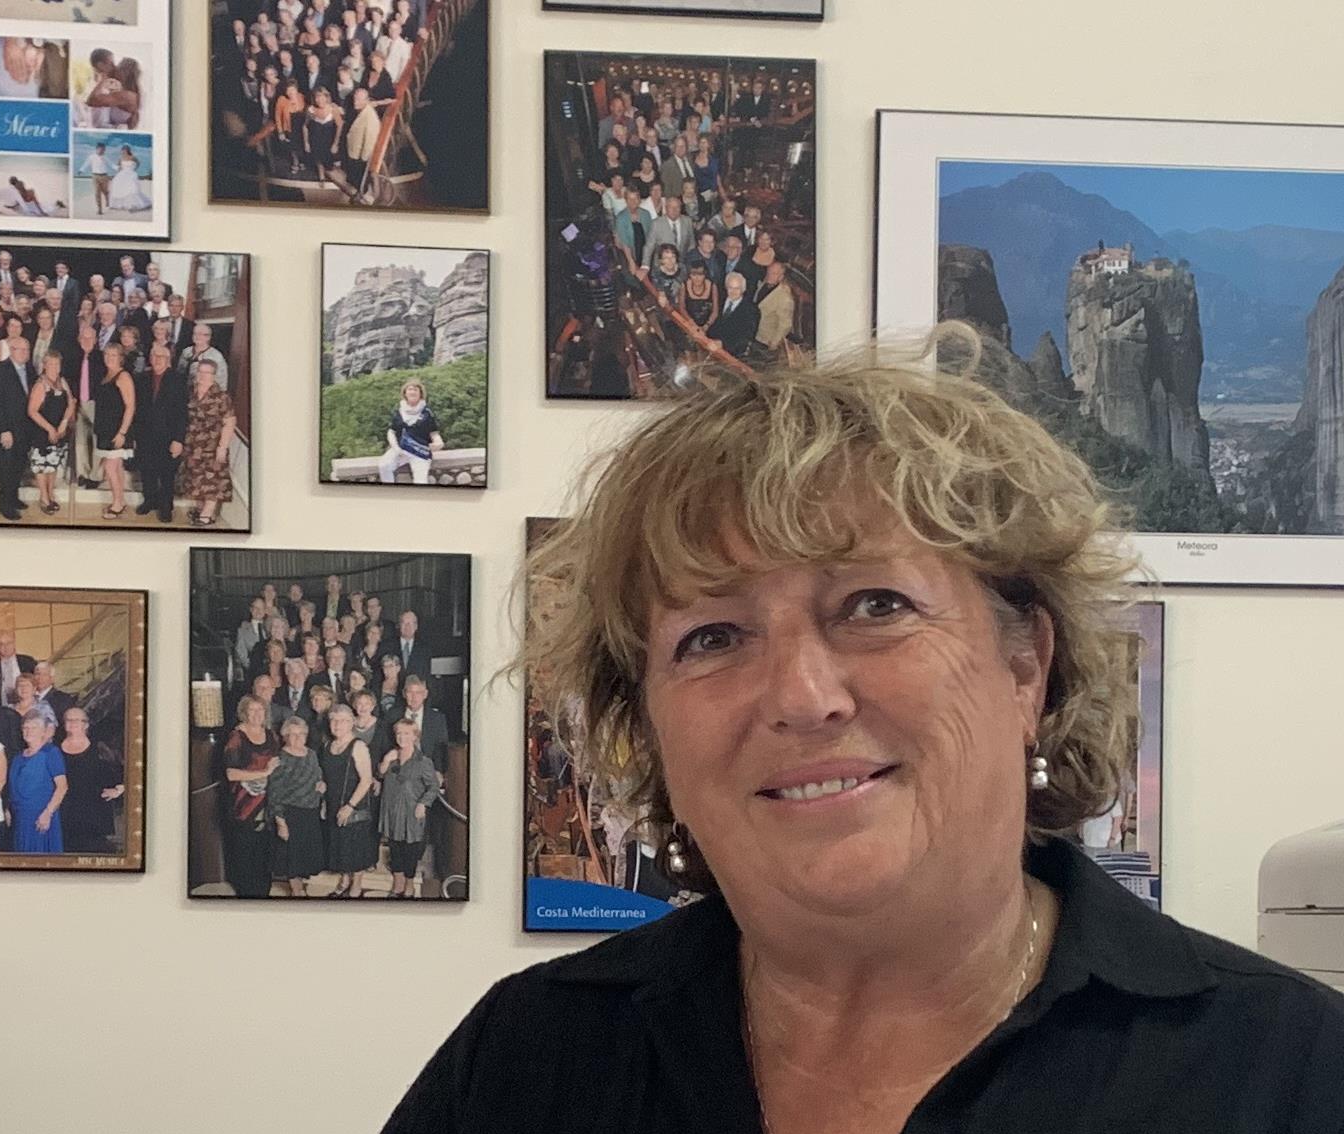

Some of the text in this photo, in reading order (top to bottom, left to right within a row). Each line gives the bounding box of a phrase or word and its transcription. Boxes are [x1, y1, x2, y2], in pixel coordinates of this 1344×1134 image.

[0, 112, 60, 138] Merci
[1176, 541, 1218, 550] Meteora
[536, 906, 646, 919] Costa Mediterranea
